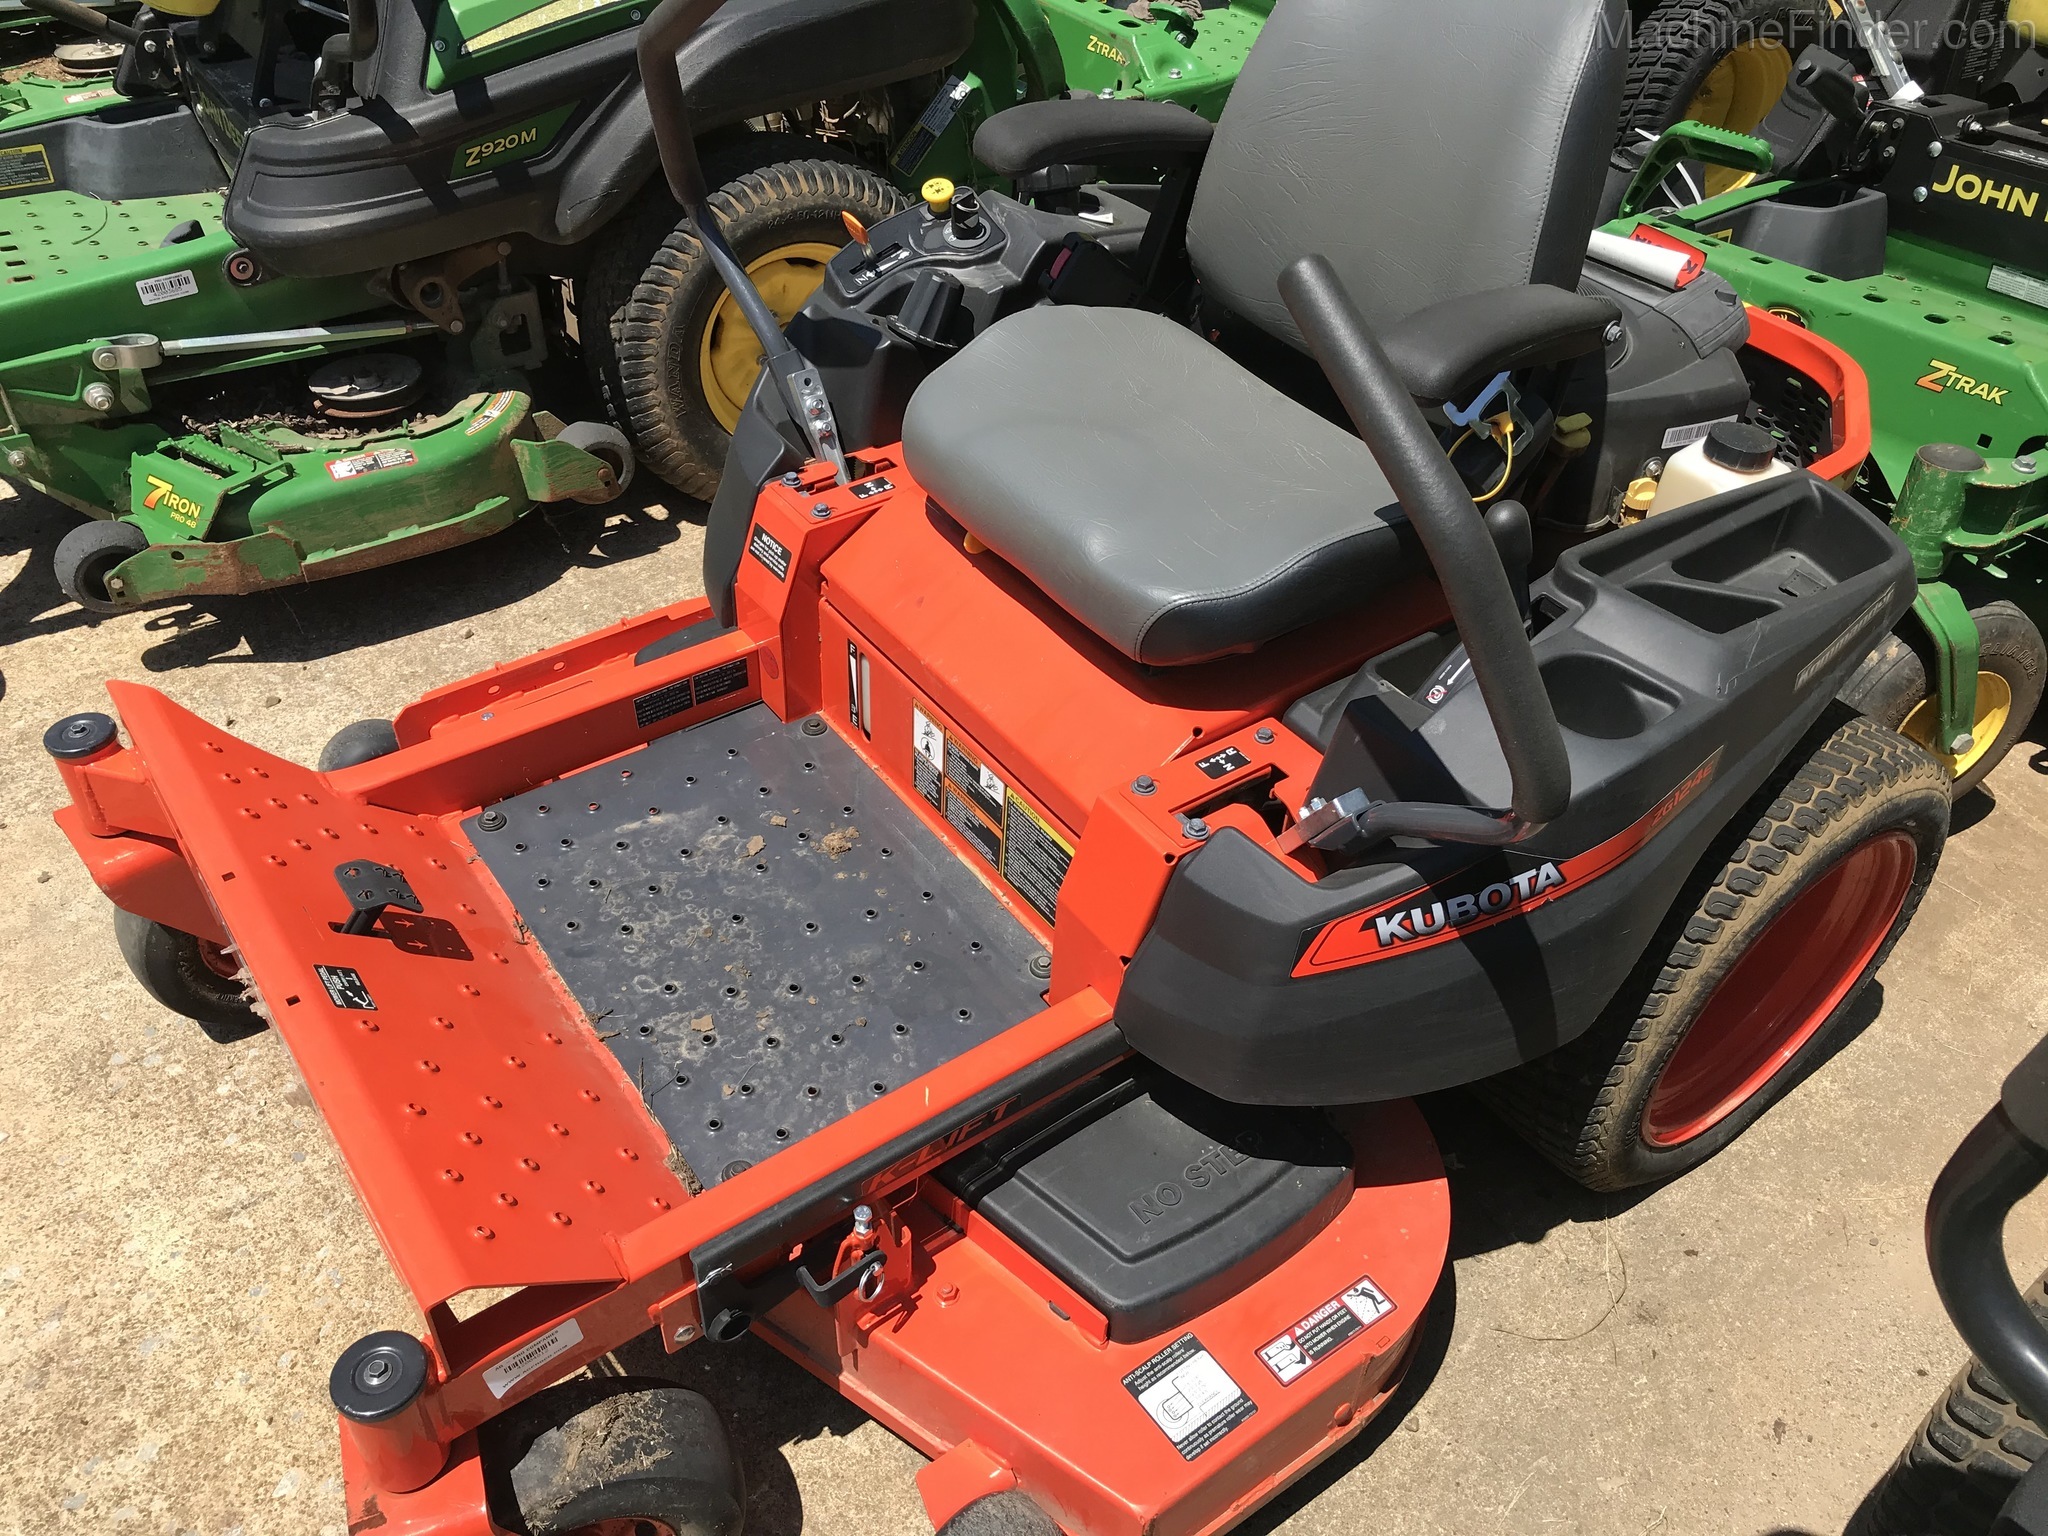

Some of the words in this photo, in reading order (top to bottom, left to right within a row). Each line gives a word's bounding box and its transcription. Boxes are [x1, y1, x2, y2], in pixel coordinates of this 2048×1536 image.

[465, 128, 537, 168] Z920M
[1932, 164, 2040, 218] JOHN
[1916, 359, 2010, 405] ZTRAK
[170, 511, 186, 524] PRO
[185, 519, 198, 530] 48
[761, 532, 782, 556] NOTICE
[1015, 796, 1041, 824] CAUTION
[1650, 760, 1715, 829] ZG124E
[1375, 861, 1566, 946] KUBOTA
[330, 975, 345, 990] PUSH
[1128, 1181, 1184, 1225] NO
[1300, 1299, 1341, 1331] DANGER
[1302, 1340, 1313, 1349] INTO
[1311, 1331, 1327, 1343] MOWER
[1325, 1323, 1338, 1333] WHEN
[1335, 1314, 1352, 1326] ENGINE
[1303, 1331, 1313, 1339] NOT
[1310, 1326, 1320, 1334] PUT
[1318, 1317, 1333, 1329] HANDS
[1336, 1307, 1347, 1316] FEET
[525, 1329, 559, 1352] COMPANIES
[1121, 1360, 1153, 1384] ANTI-SCALP
[1149, 1347, 1173, 1364] ROLLER
[1170, 1332, 1193, 1350] SETTING
[1132, 1374, 1148, 1386] Adjust
[1152, 1356, 1173, 1372] anti-scalp
[1136, 1379, 1153, 1391] height
[1154, 1356, 1184, 1377] recommended
[1175, 1439, 1189, 1450] Never
[1187, 1431, 1199, 1441] allow
[1196, 1425, 1208, 1434] roller
[1210, 1412, 1226, 1424] contact
[1228, 1398, 1245, 1410] ground
[1180, 1436, 1205, 1455] continuously
[1206, 1419, 1228, 1435] premature
[1224, 1411, 1236, 1421] roller
[1233, 1405, 1245, 1414] wear
[1185, 1447, 1202, 1461] develop
